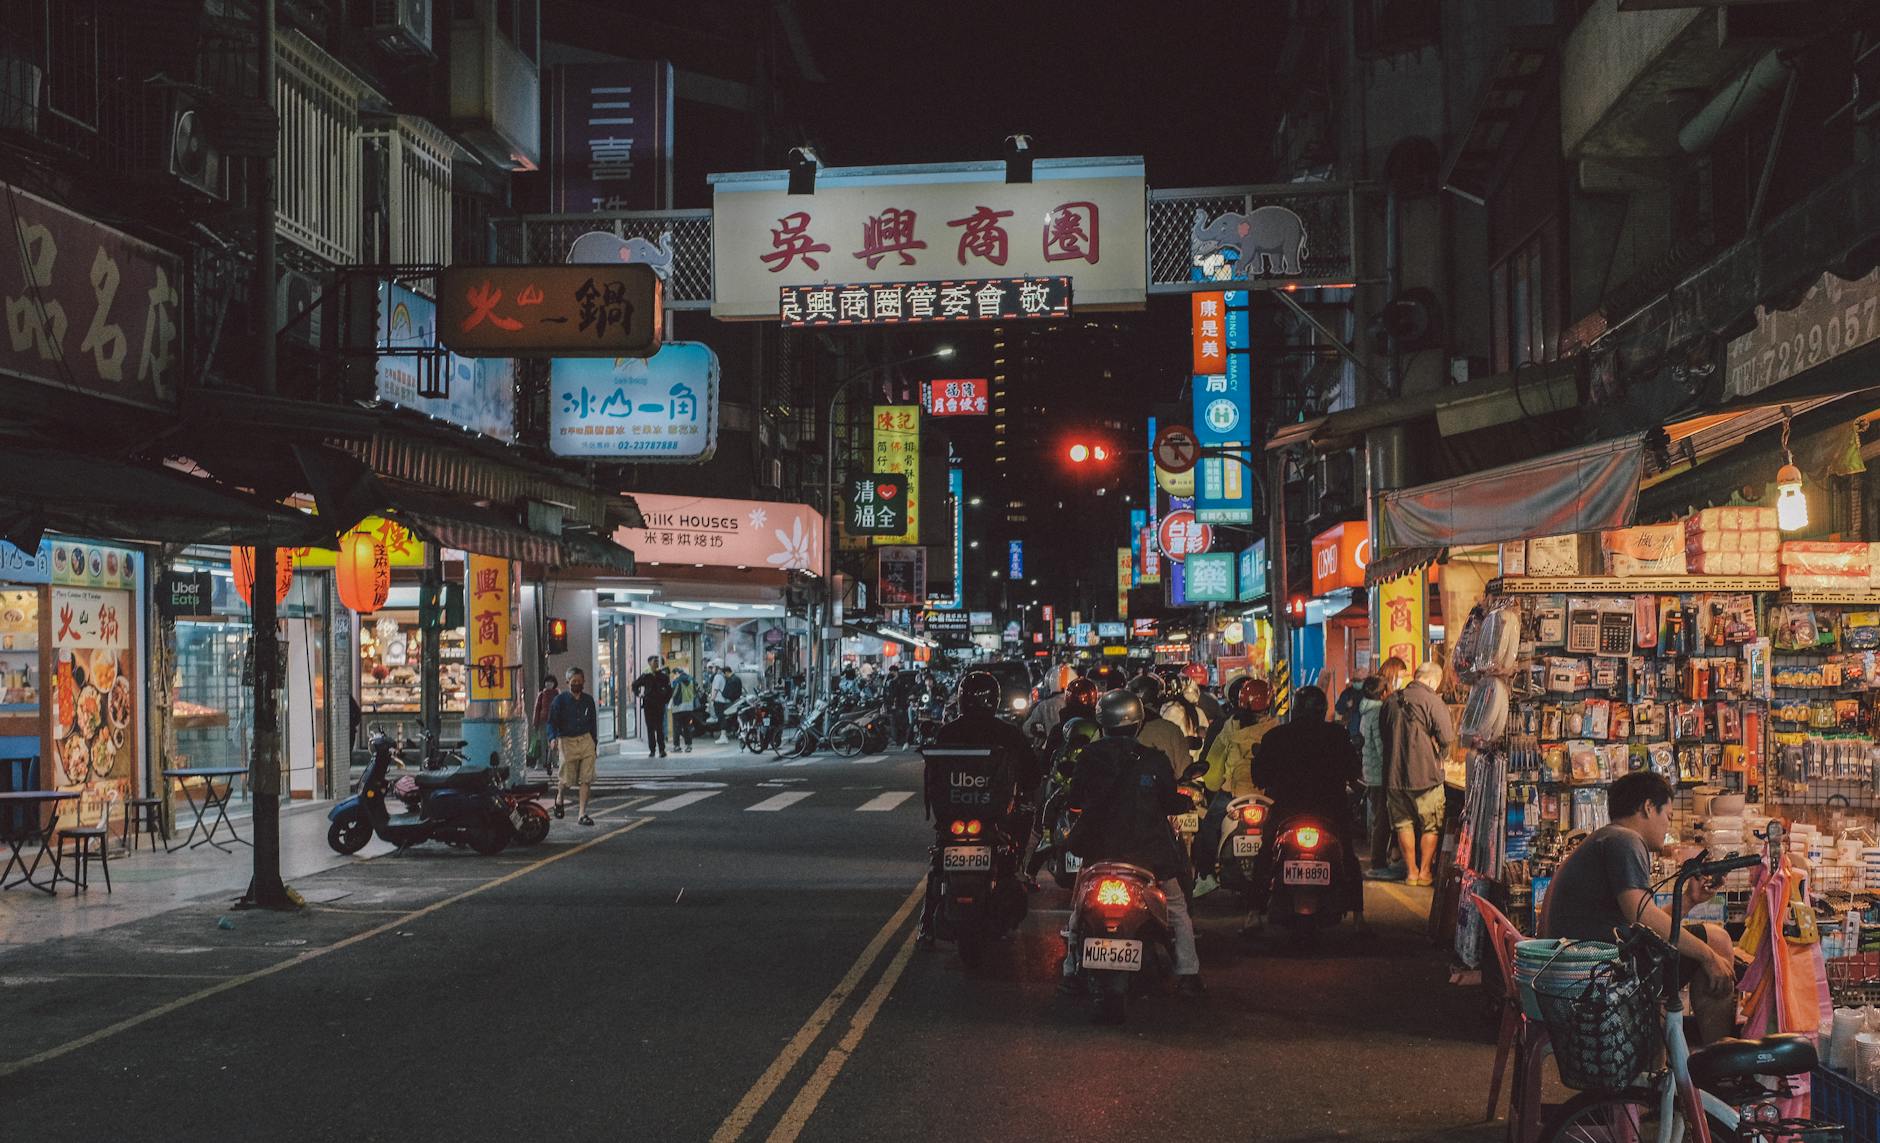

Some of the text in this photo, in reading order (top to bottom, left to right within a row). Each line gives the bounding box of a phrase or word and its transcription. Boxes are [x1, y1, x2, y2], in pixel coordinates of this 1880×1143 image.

[758, 200, 1101, 273] 吳興商圈
[460, 277, 635, 338] 火山一鍋
[1019, 281, 1051, 313] 敬
[1200, 300, 1219, 358] 康是美
[1228, 304, 1238, 391] PRING PARMACY
[1206, 376, 1228, 392] 局
[562, 382, 698, 421] 冰山一角
[877, 411, 915, 430] 陳記
[854, 480, 875, 503] 清
[855, 504, 896, 528] 福全
[643, 532, 724, 548] 米哥烘焙坊
[1317, 544, 1338, 580] COSMED
[171, 581, 200, 594] Uber
[1193, 559, 1227, 595] 藥
[171, 594, 200, 606] Eats
[58, 601, 119, 646] 火山一鍋
[474, 568, 505, 690] 興商圈
[950, 771, 990, 787] Uber
[950, 789, 990, 804] Eats
[1085, 946, 1140, 964] MUR-5682
